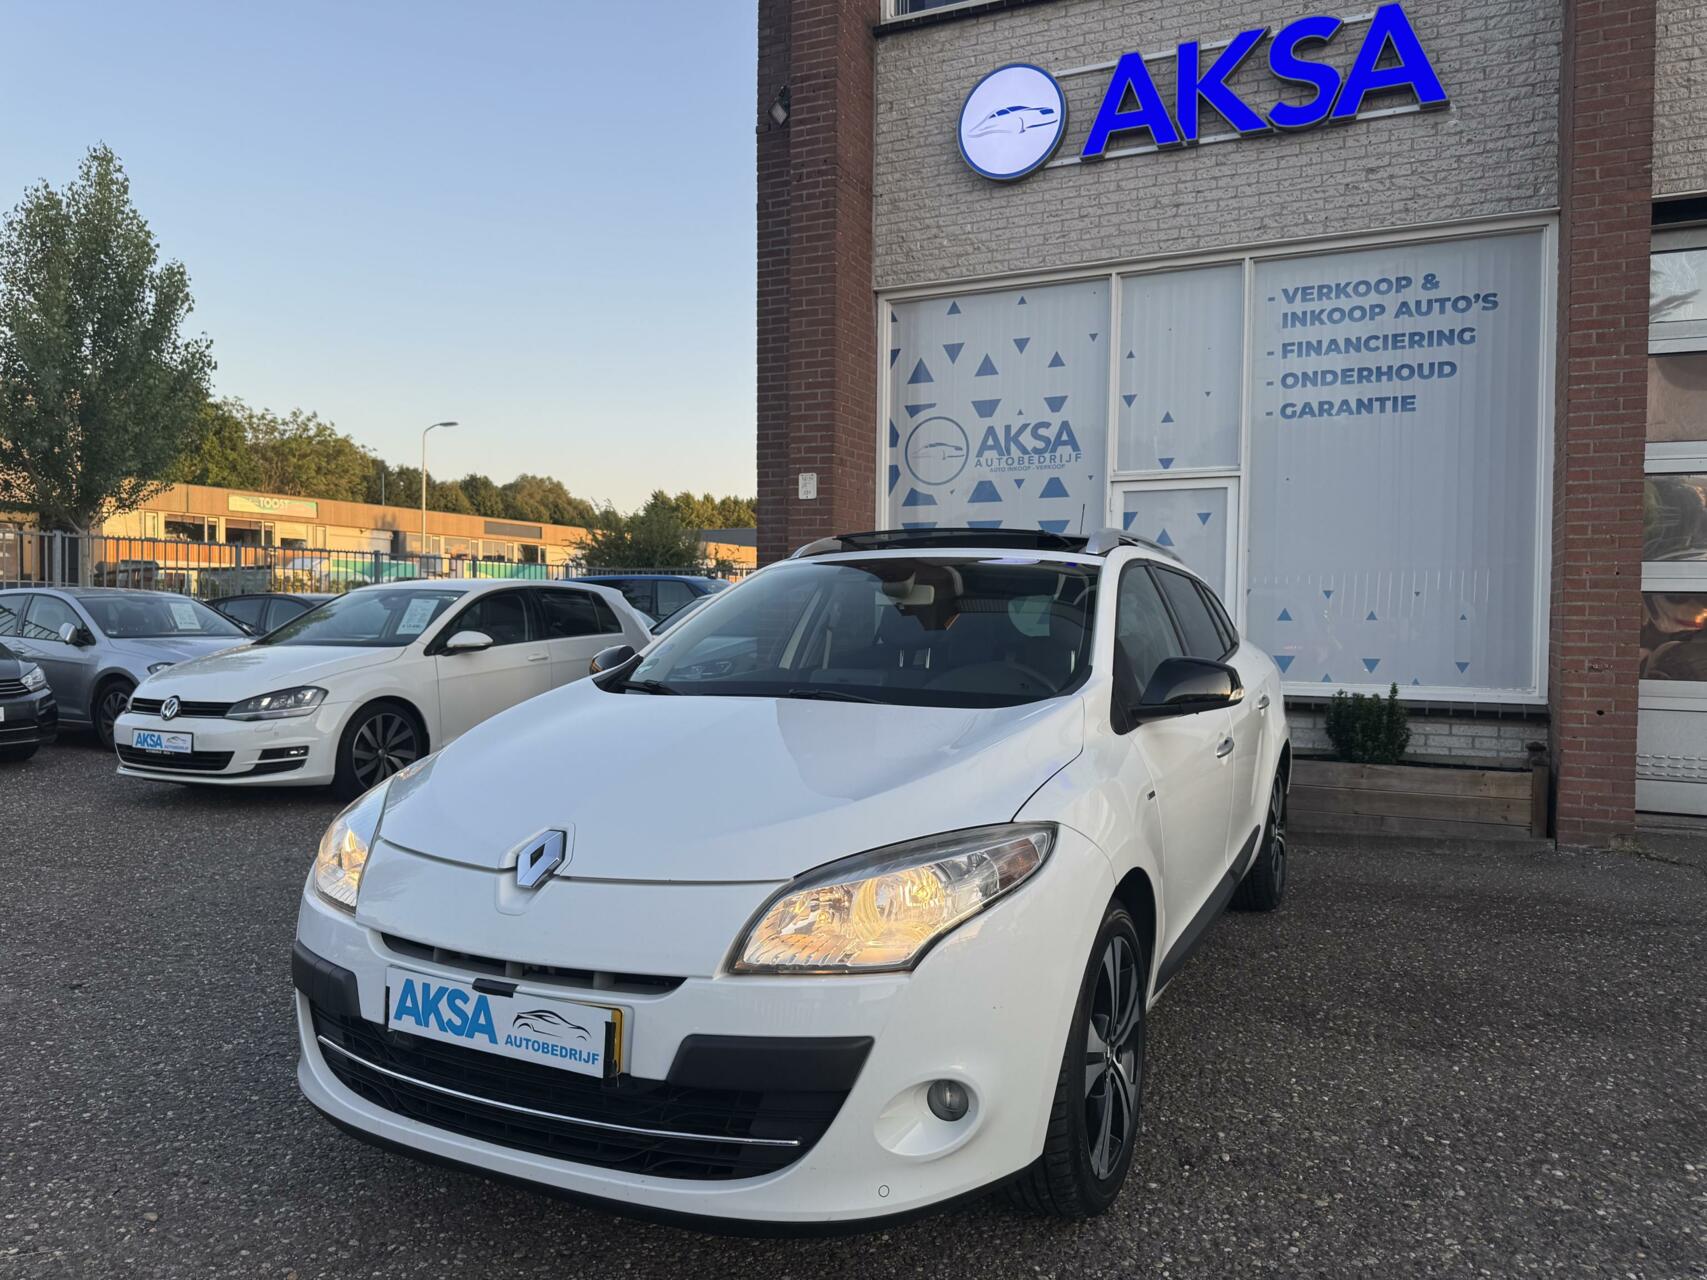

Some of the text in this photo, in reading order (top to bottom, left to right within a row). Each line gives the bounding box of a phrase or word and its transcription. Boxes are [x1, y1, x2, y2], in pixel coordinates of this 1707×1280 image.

[1080, 3, 1449, 159] AKSA
[1281, 276, 1413, 304] VERKOOP
[1421, 273, 1440, 291] &
[1281, 292, 1500, 329] INKOOP AUTO'S
[1281, 327, 1476, 359] FINANCIERING
[1280, 360, 1457, 389] ONDERHOUD
[1279, 394, 1417, 419] GARANTIE
[975, 420, 1081, 458] AKSA
[974, 453, 1082, 468] AUTOBEDRIJF
[135, 732, 163, 749] AKSA
[393, 978, 498, 1045] AKSA
[504, 1034, 599, 1065] AUTOBEDRIJF
